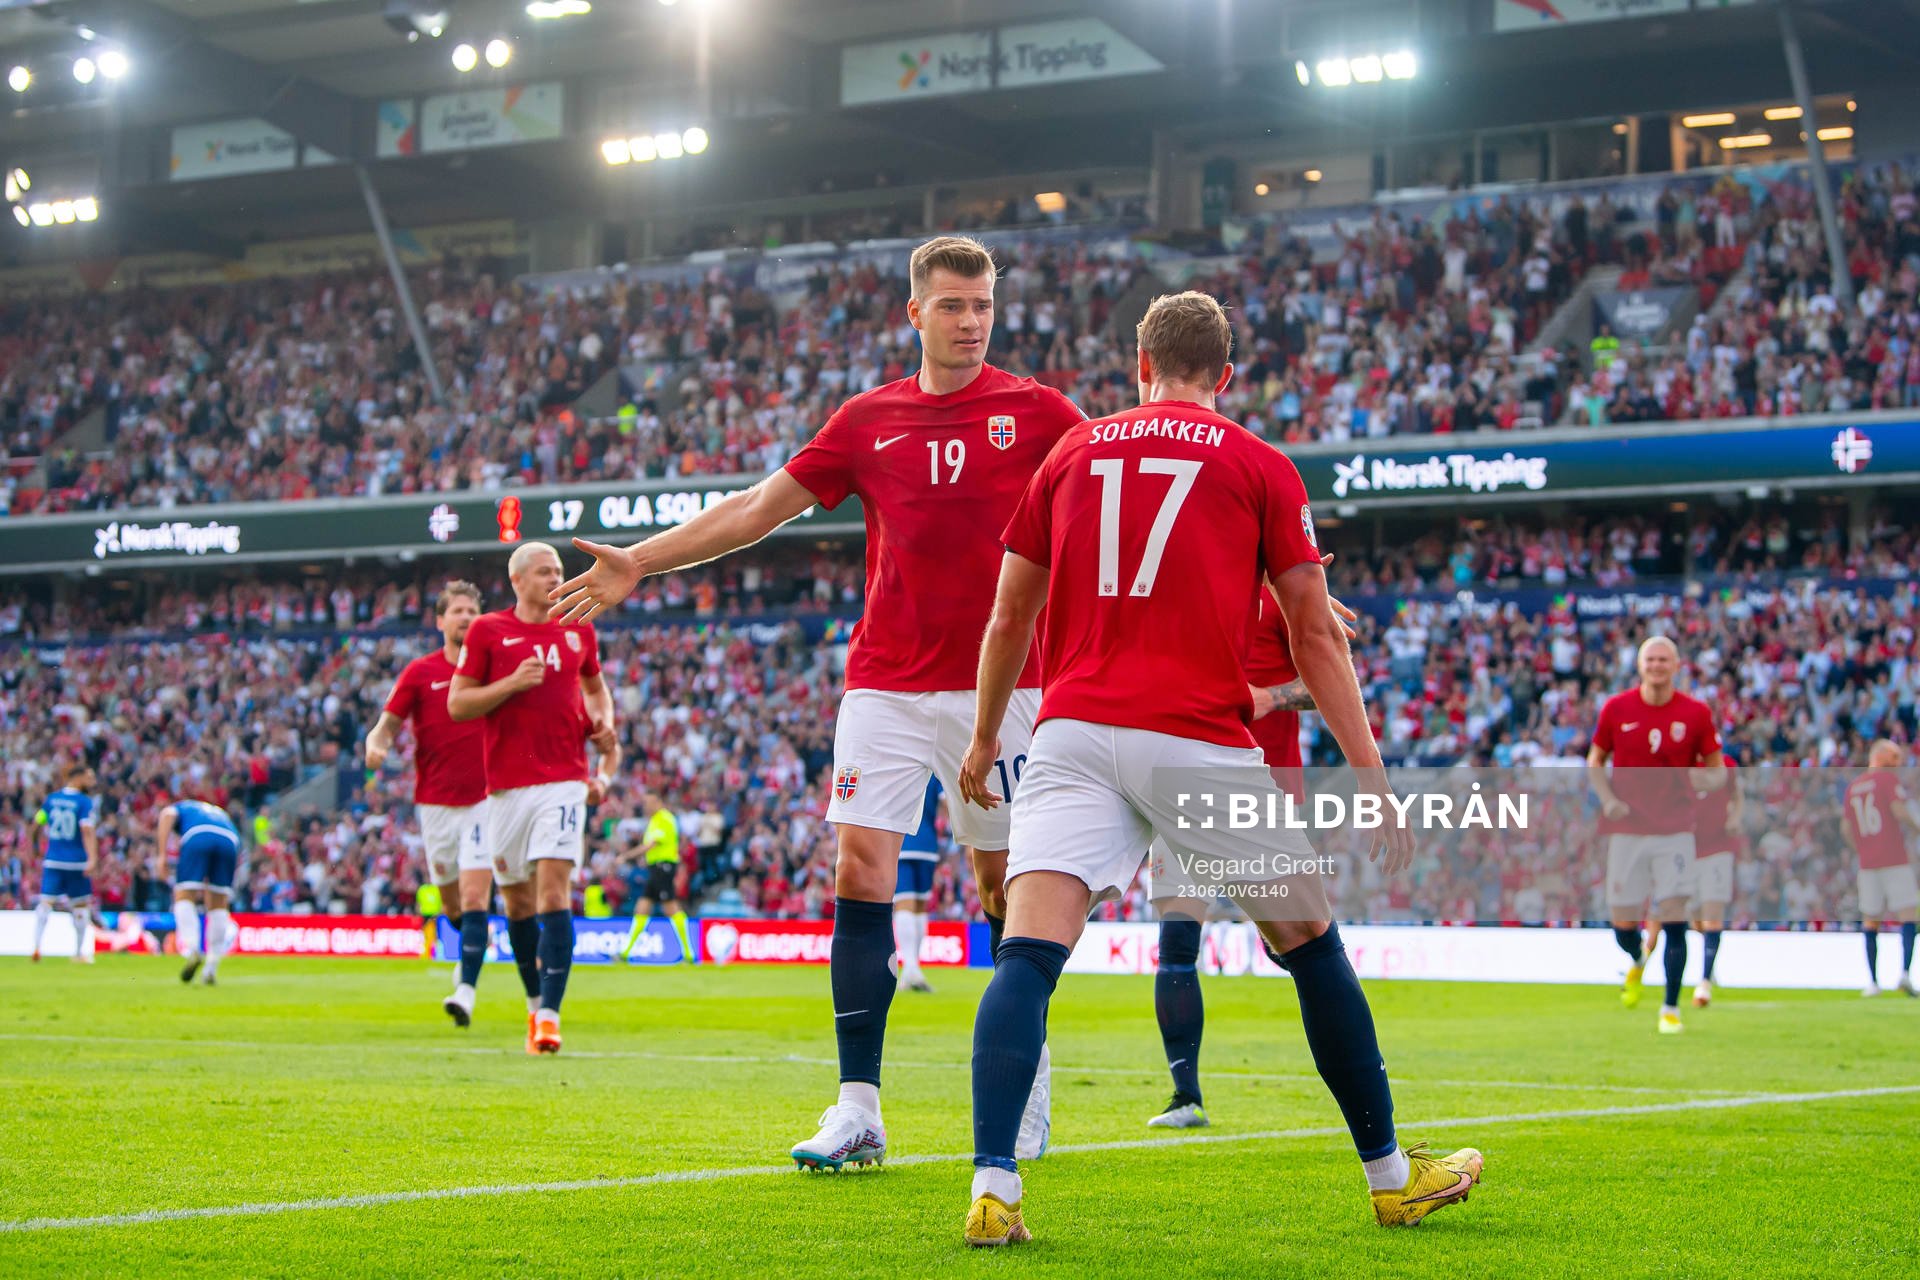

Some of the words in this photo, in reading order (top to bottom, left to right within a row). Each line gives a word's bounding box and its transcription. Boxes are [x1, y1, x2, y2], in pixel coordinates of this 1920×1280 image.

[1015, 38, 1108, 75] Tipping
[1088, 417, 1226, 447] SOLBAKKEN
[926, 438, 966, 485] 19
[1371, 456, 1449, 490] Norsk
[1446, 452, 1547, 492] Tipping
[549, 500, 583, 531] 17
[599, 495, 653, 528] OLA
[1090, 457, 1204, 597] 17
[121, 522, 173, 551] Norsk
[171, 521, 240, 555] Tipping
[533, 643, 561, 673] 14
[1648, 728, 1663, 754] 9
[49, 807, 77, 840] 20
[559, 805, 577, 832] 14
[1850, 791, 1883, 838] 16
[470, 823, 481, 845] 4
[239, 926, 330, 952] EUROPEAN
[739, 933, 832, 961] EUROPEA
